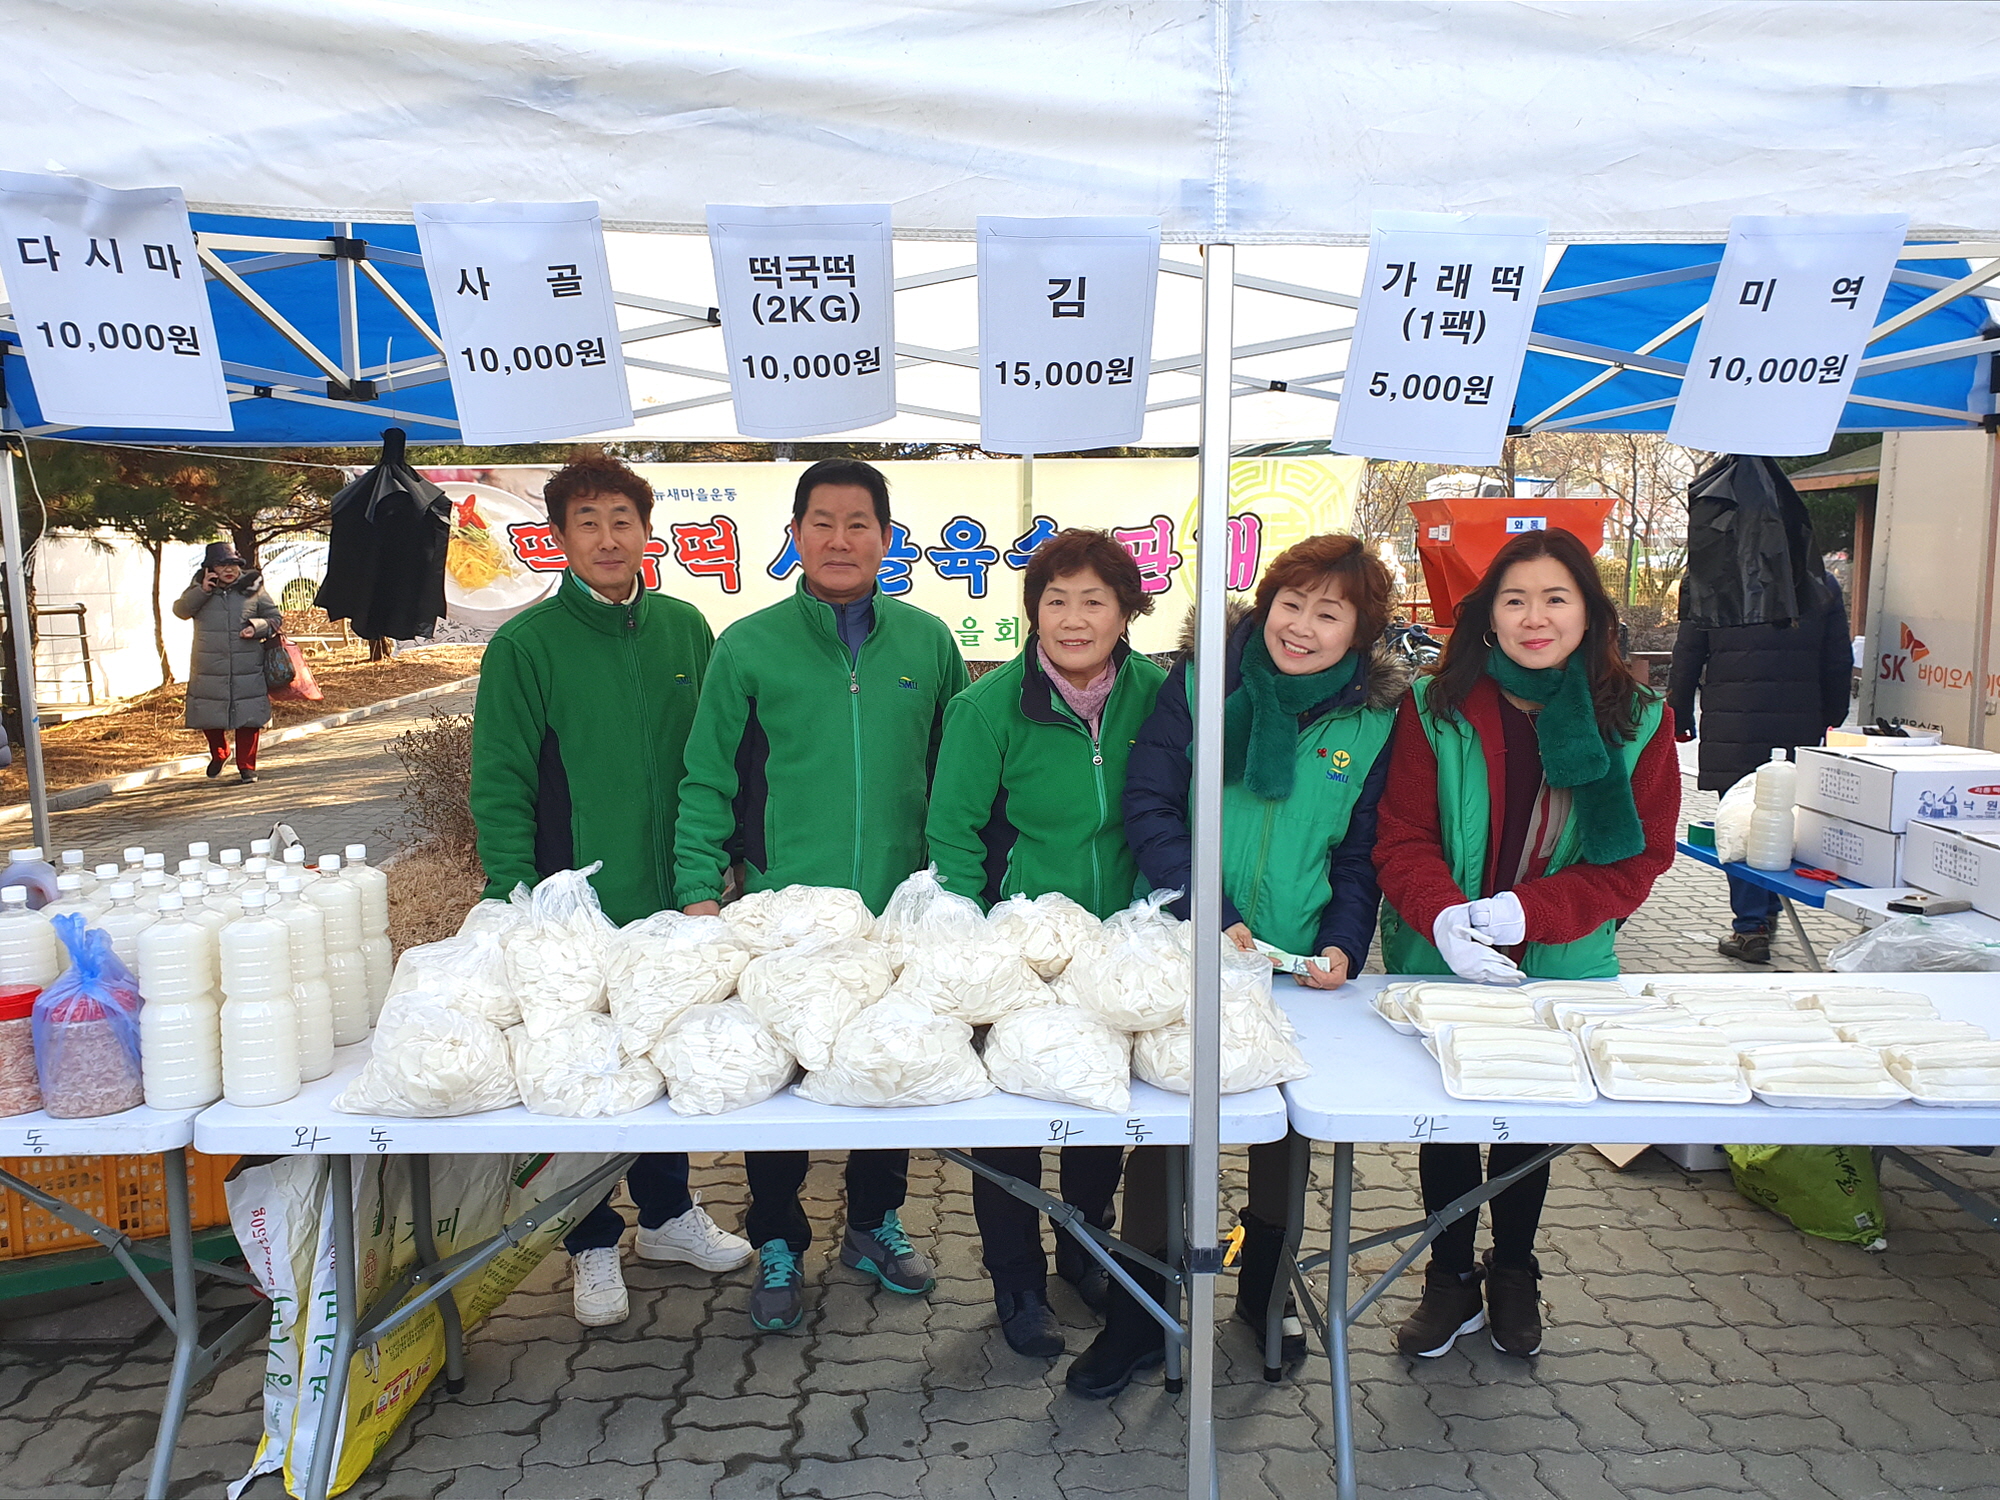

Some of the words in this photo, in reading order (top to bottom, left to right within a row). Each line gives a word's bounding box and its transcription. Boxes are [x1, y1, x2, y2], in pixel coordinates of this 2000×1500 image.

[747, 253, 857, 290] 떡국떡
[751, 290, 862, 326] (2KG)
[1046, 276, 1088, 319] 김
[35, 320, 202, 357] 10,000원
[1402, 307, 1487, 345] (1팩)
[460, 336, 608, 376] 10,000원
[741, 345, 882, 384] 10,000원
[994, 356, 1135, 390] 15,000원
[1708, 353, 1850, 387] 10,000원
[1368, 370, 1495, 406] 5,000원
[653, 487, 737, 502] 뉴새마을운동
[1880, 653, 1907, 683] SK
